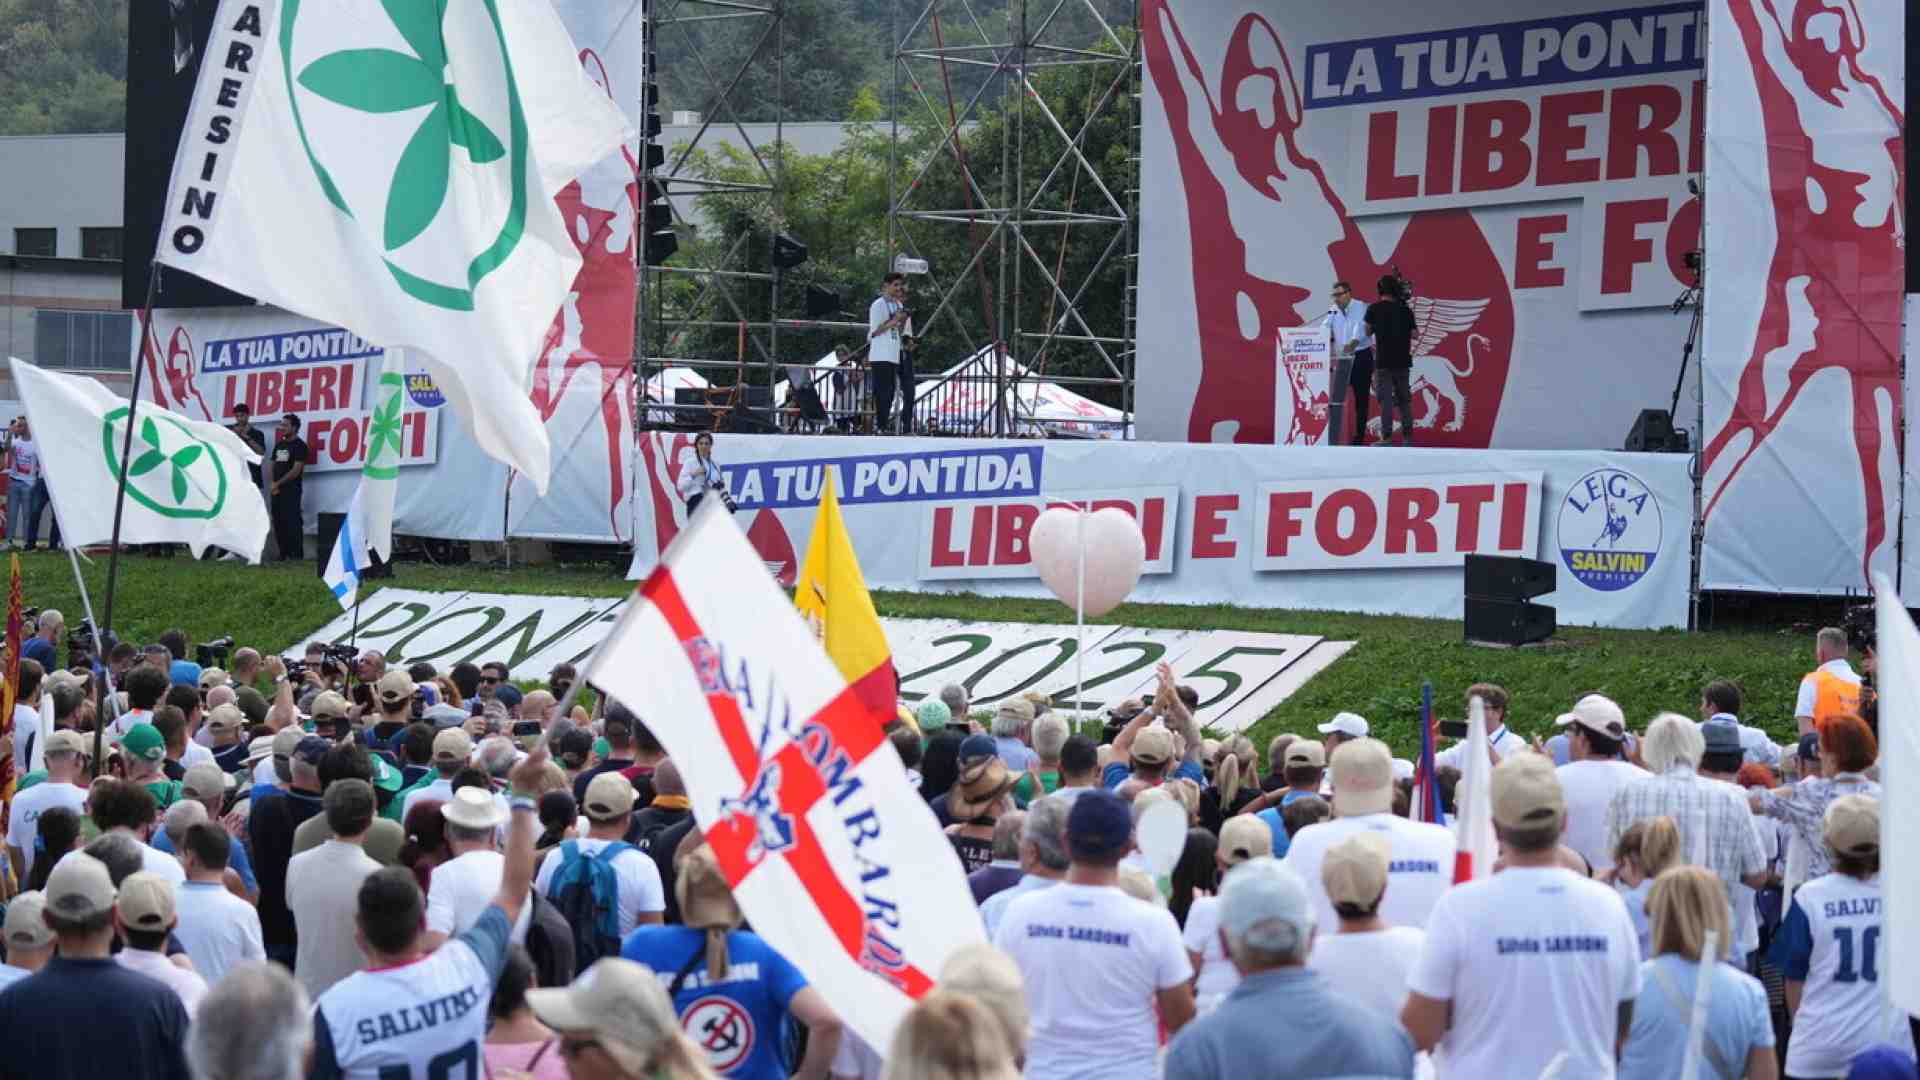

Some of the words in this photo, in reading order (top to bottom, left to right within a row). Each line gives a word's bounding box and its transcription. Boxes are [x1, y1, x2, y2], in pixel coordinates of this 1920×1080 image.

[1311, 47, 1382, 99] LA
[1395, 33, 1506, 90] TUA
[1514, 213, 1568, 289] E
[204, 343, 231, 369] LA
[237, 338, 276, 364] TUA
[223, 363, 354, 418] LIBERI
[305, 411, 426, 465] FOI
[722, 468, 765, 503] LA
[772, 463, 845, 501] TUA
[852, 452, 1035, 498] PONTIDA
[1568, 473, 1649, 515] LEGA
[930, 497, 1165, 567] LIBI
[1191, 494, 1240, 559] E
[1266, 483, 1528, 557] FORTI
[1571, 551, 1646, 572] SALVINI
[893, 633, 1287, 709] 2025
